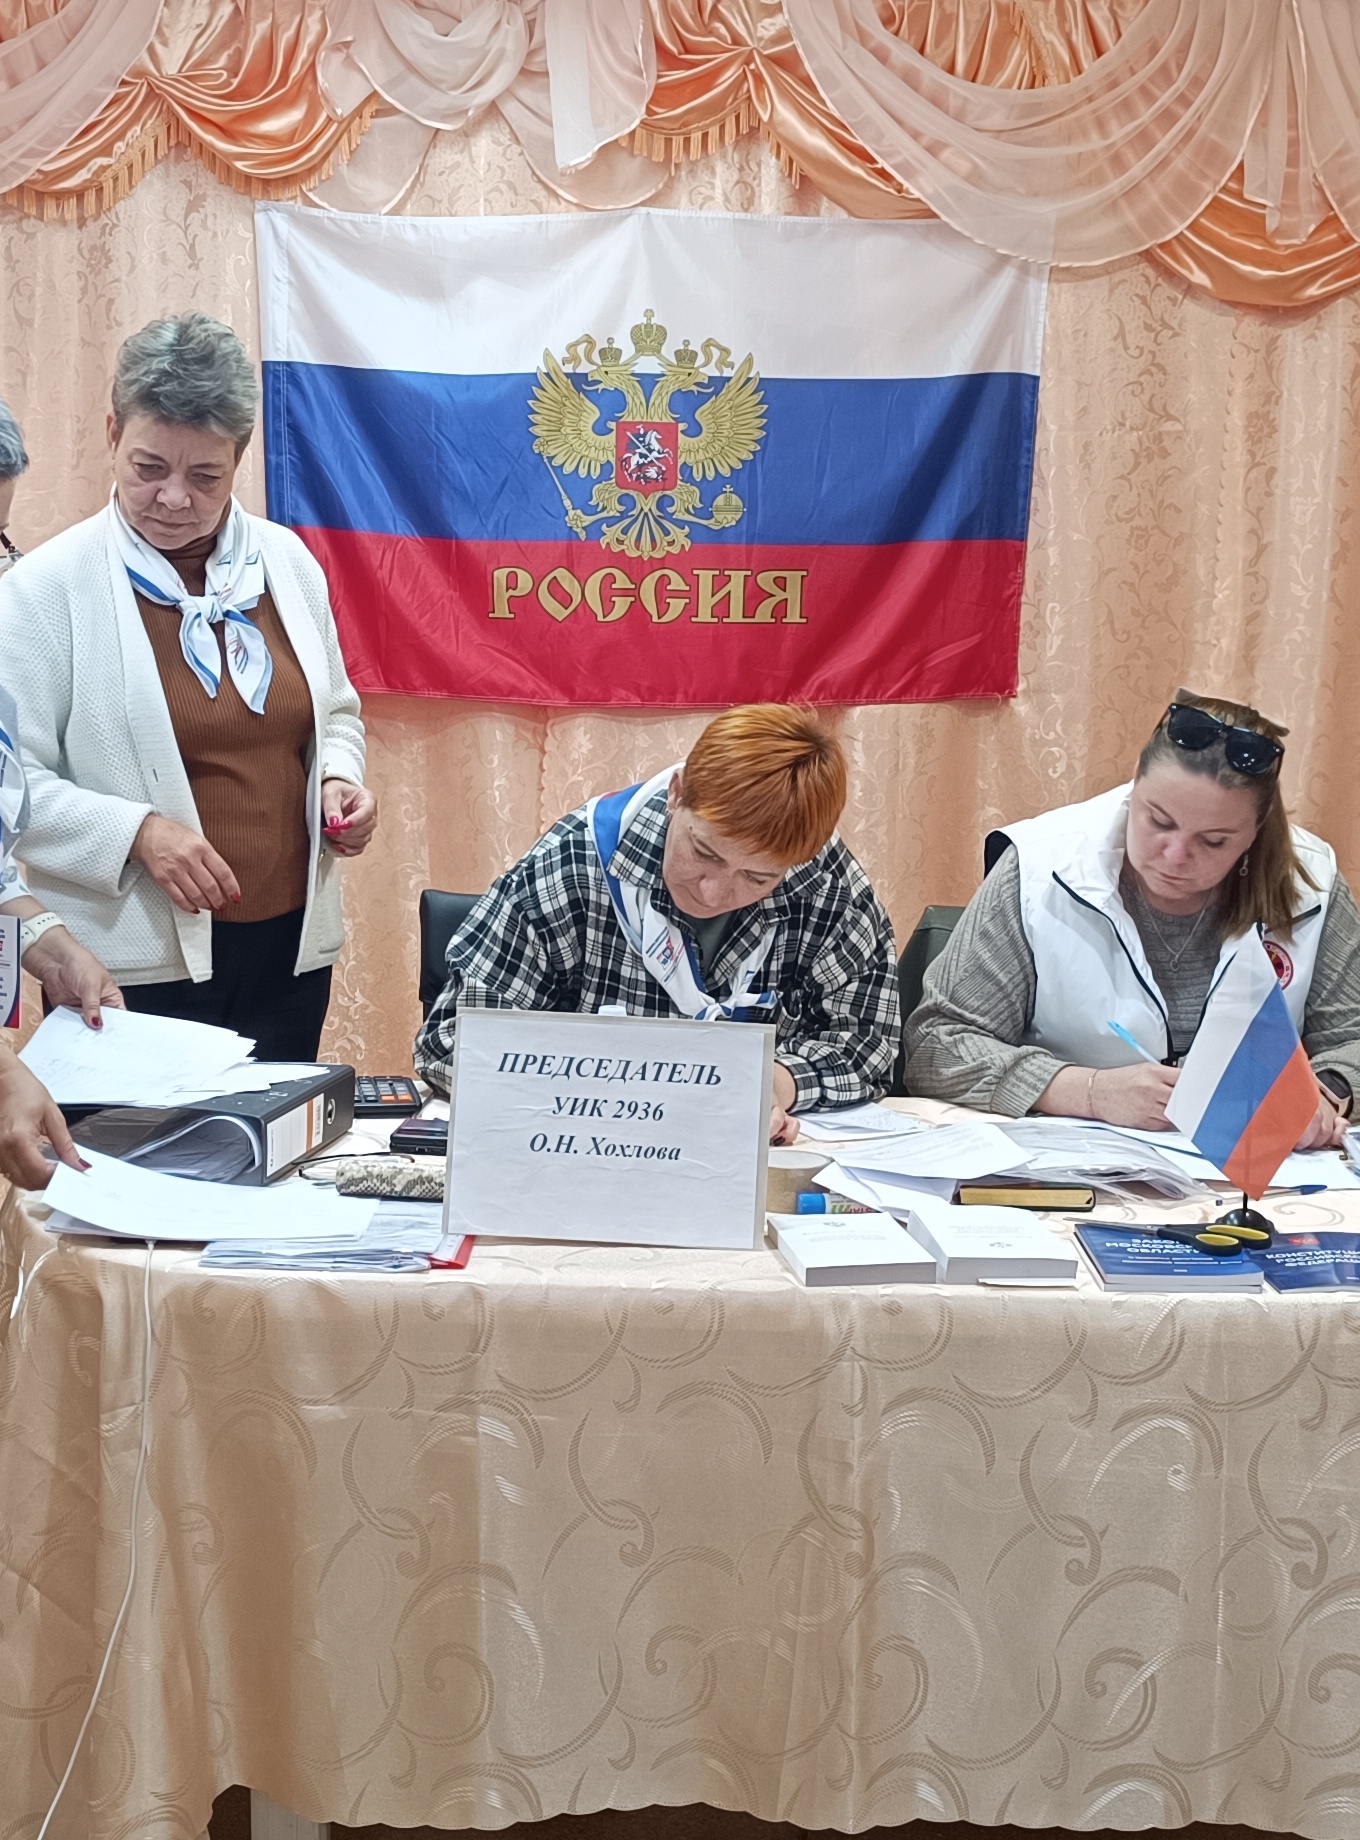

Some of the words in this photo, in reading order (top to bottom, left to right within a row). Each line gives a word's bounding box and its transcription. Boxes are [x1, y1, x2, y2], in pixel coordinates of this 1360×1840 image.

[488, 566, 809, 624] РОССИЯ
[496, 1052, 722, 1086] ПРЕДСЕДАТЕЛЬ
[552, 1096, 608, 1118] УИК
[612, 1099, 665, 1122] 2936
[529, 1132, 579, 1155] О.Н.
[586, 1136, 682, 1161] Хохлова
